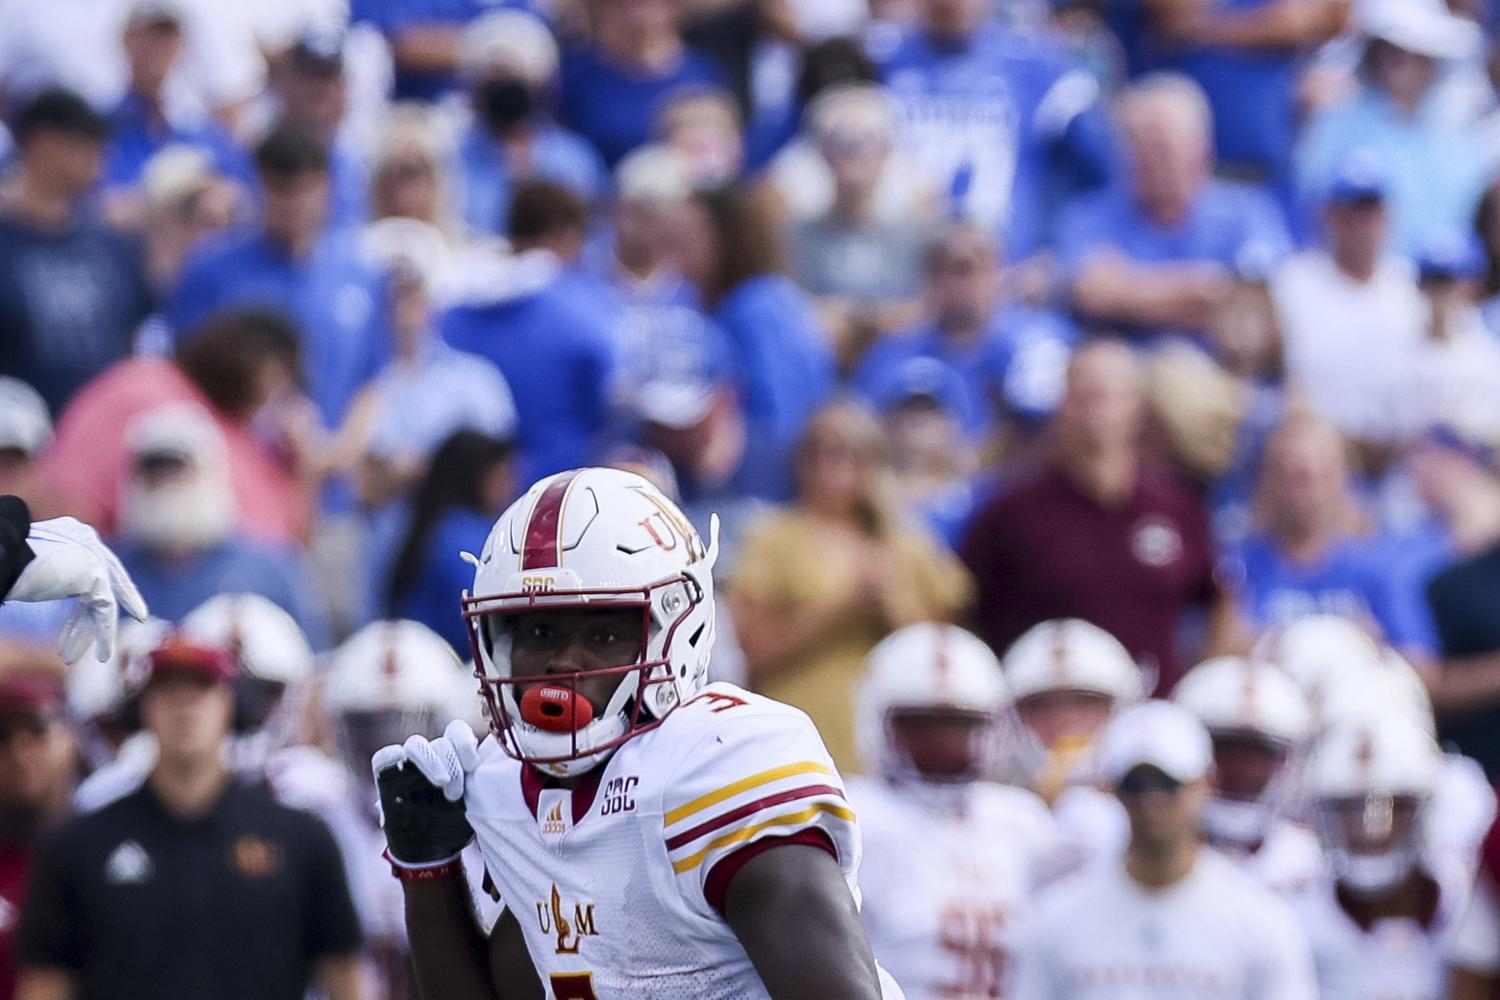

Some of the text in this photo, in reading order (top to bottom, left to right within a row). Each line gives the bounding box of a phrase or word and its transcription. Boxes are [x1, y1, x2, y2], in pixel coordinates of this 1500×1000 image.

[600, 776, 640, 816] SBC
[542, 822, 566, 834] adidas
[536, 882, 600, 955] ULM
